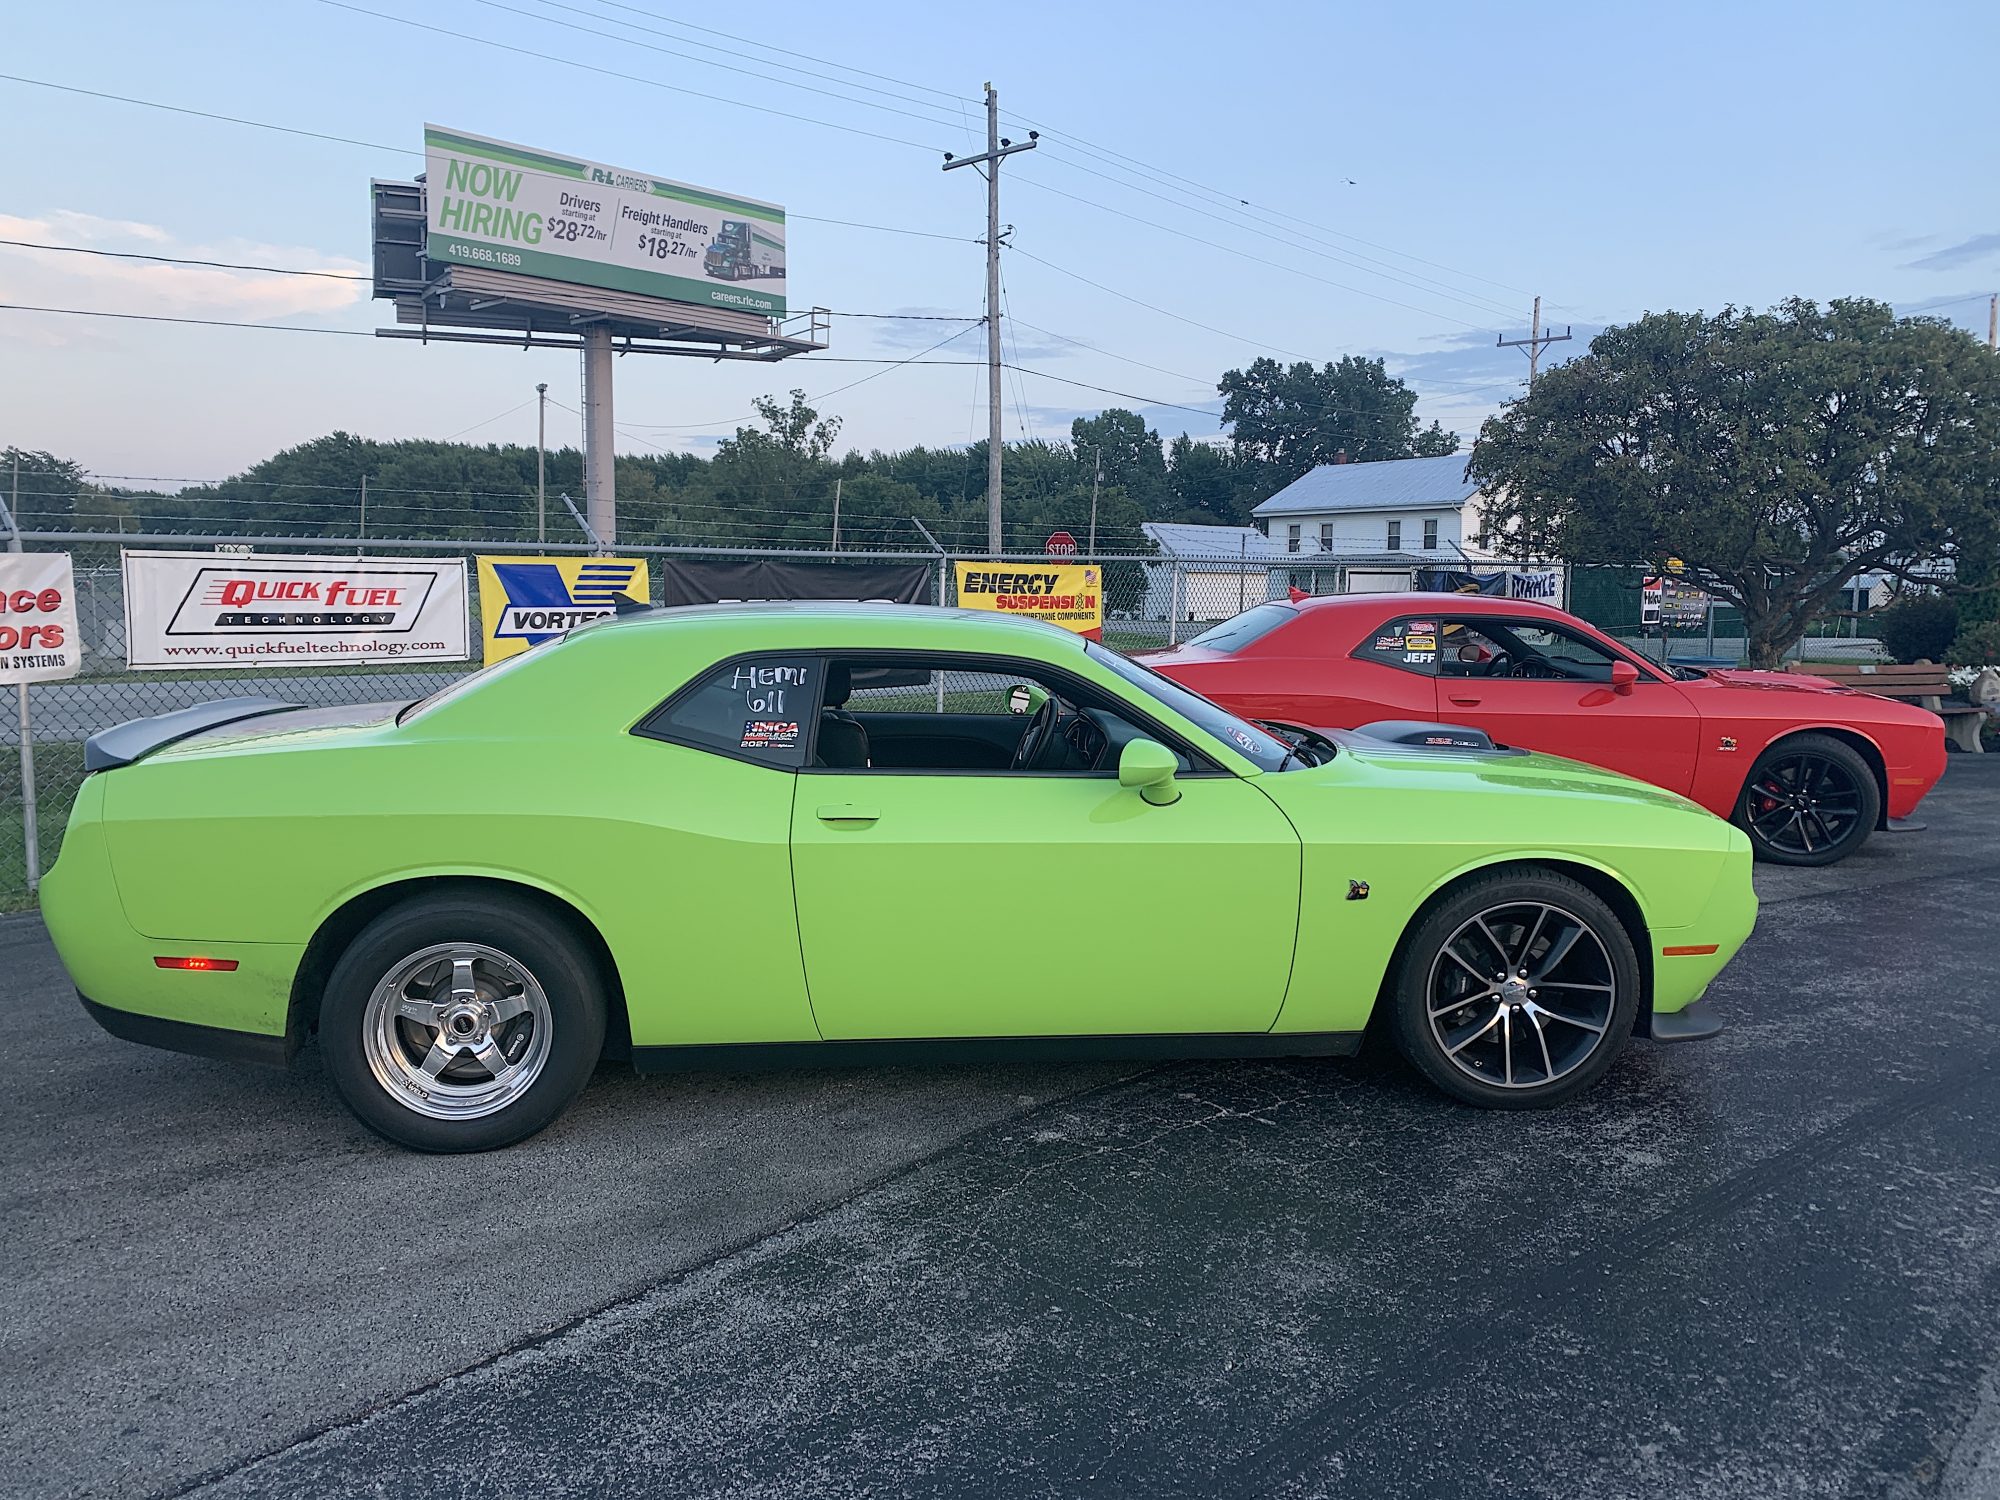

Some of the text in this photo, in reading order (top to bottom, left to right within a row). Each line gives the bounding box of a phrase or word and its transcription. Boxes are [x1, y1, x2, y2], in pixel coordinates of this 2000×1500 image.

[445, 159, 523, 202] NOW
[616, 174, 648, 192] CARRIERS
[560, 192, 601, 213] Drivers
[439, 197, 543, 245] HIRING
[561, 207, 596, 221] starting at
[622, 206, 708, 235] Freight Handlers
[547, 217, 608, 243] $28.72/hr
[651, 227, 682, 239] starting at
[448, 244, 521, 266] 419.668.1689
[638, 234, 698, 259] $18.27/hr
[711, 289, 772, 310] careers.rlc.com
[1048, 543, 1074, 555] STOP
[964, 572, 1060, 594] ENERGY
[226, 615, 387, 624] TECHNOLOGY
[1057, 612, 1096, 620] COMPONENTS
[164, 639, 446, 659] www.quickfueltechnology.com
[1403, 653, 1436, 663] JEFF
[13, 654, 66, 670] SYSTEMS
[731, 666, 807, 689] HEMI
[408, 1083, 428, 1098] WELD
